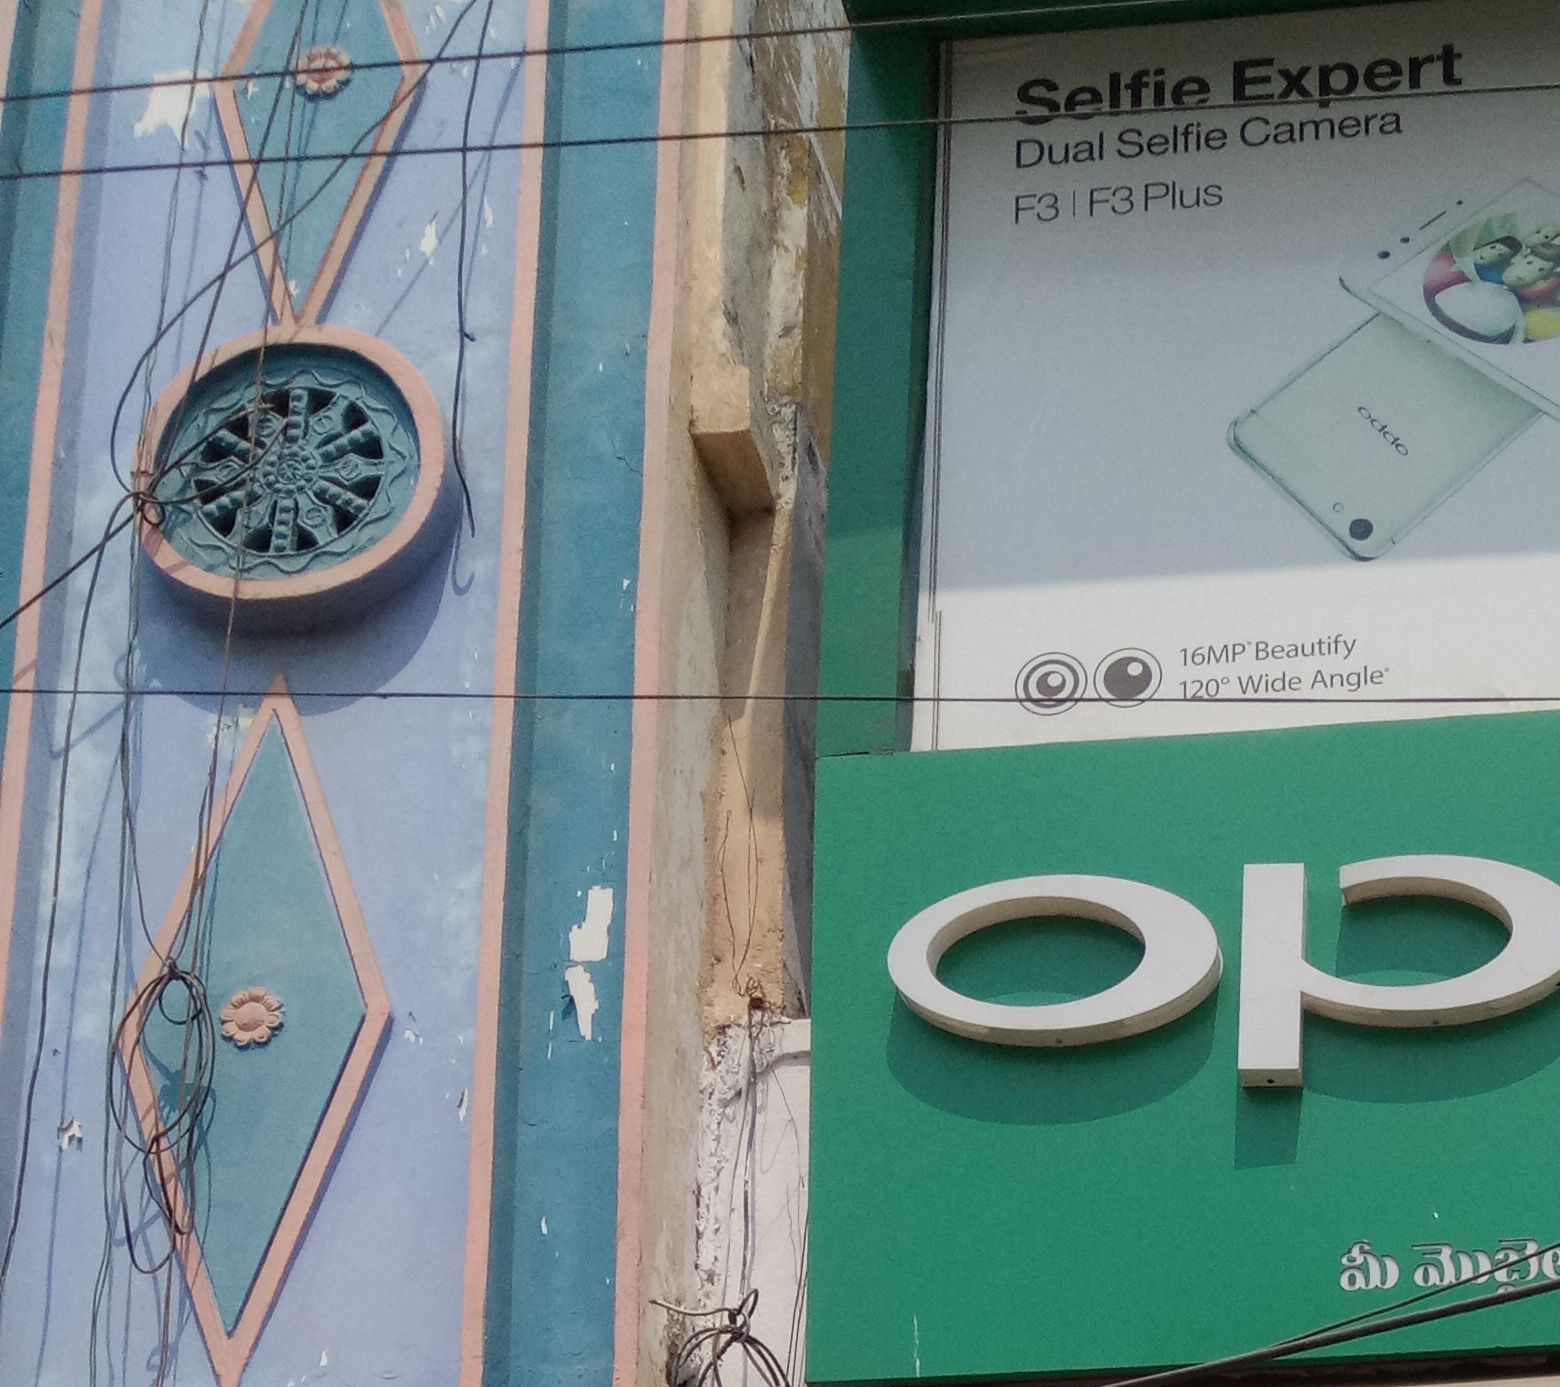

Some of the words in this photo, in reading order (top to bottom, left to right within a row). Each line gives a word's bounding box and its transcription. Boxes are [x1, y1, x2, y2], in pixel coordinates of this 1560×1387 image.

[1014, 66, 1211, 126] Selfie
[1231, 43, 1464, 112] Expert
[1015, 132, 1105, 170] Dual
[1116, 119, 1228, 161] Selfie
[1239, 107, 1404, 149] Camera
[1013, 192, 1061, 225] F3
[1088, 184, 1136, 219] F3
[1143, 180, 1225, 214] Plus
[1254, 633, 1357, 662] Beautify
[1178, 675, 1231, 700] 120°
[1237, 670, 1302, 696] Wide
[1339, 1238, 1400, 1292] మీ
